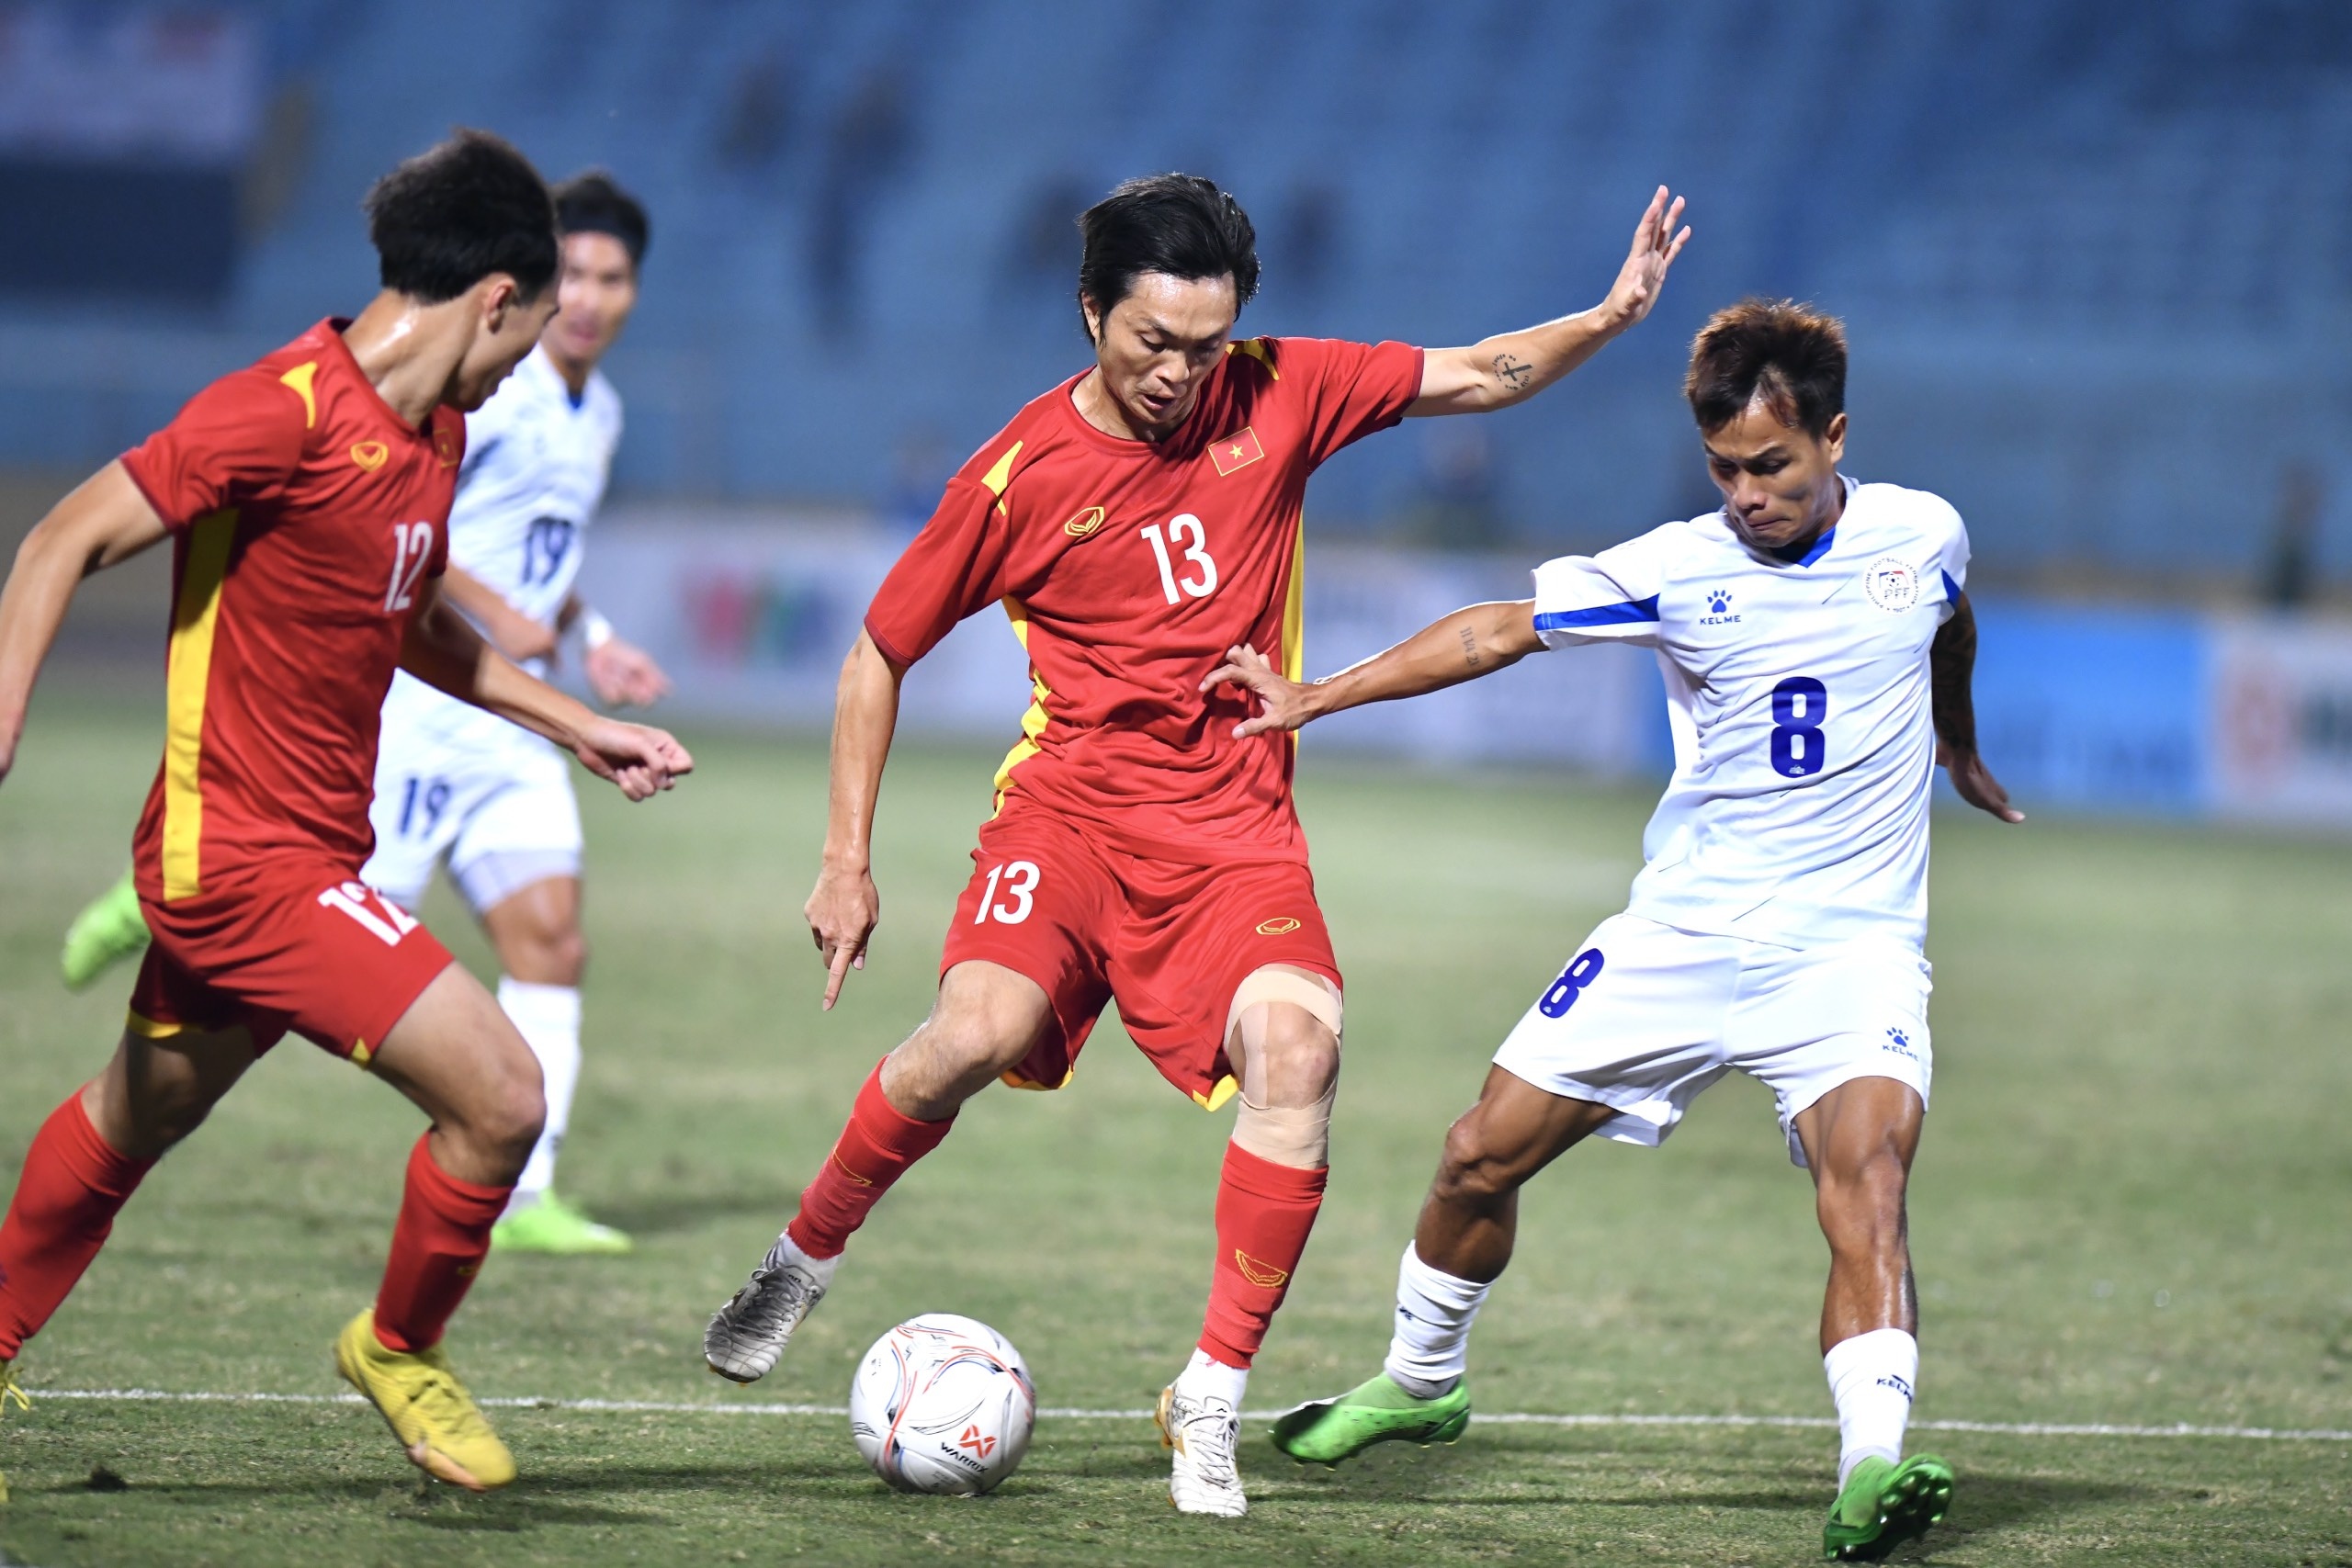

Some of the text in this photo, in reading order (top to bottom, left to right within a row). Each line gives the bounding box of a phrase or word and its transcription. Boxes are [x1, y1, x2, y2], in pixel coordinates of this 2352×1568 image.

[383, 521, 434, 613] 12
[522, 514, 573, 585] 19
[1140, 513, 1218, 605] 13
[1700, 615, 1741, 626] KELME
[1770, 676, 1826, 779] 8
[399, 775, 451, 840] 19
[974, 860, 1041, 925] 13
[1539, 947, 1605, 1019] 8
[1882, 1044, 1918, 1062] KELME
[941, 1441, 989, 1474] WARRIX
